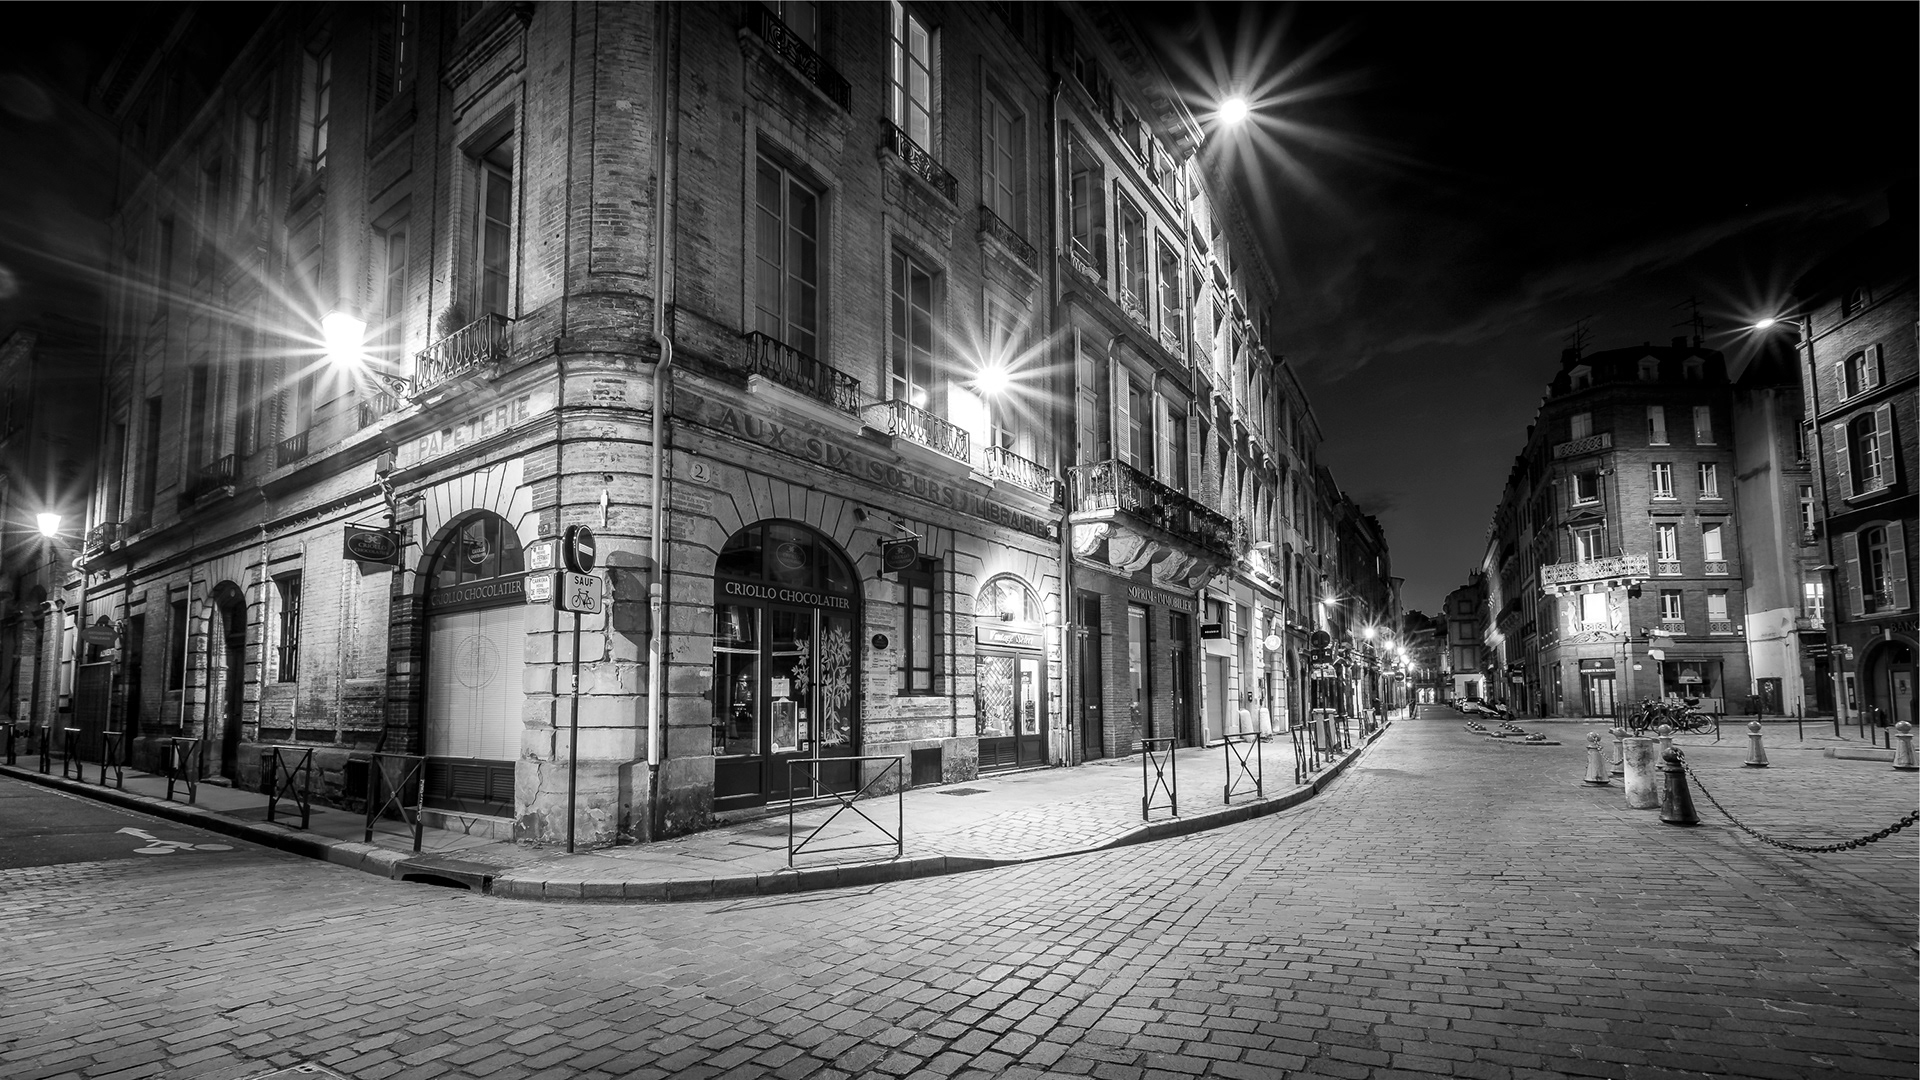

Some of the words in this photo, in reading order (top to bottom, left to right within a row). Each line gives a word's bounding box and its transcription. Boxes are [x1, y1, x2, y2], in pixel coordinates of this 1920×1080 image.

[418, 394, 531, 459] PAPETERIE
[719, 407, 787, 449] AUX
[806, 438, 851, 469] SIX
[975, 497, 1045, 537] LIBRAIRIE
[431, 590, 463, 606] CRIOLLO
[464, 580, 523, 601] CHOCOLATIER
[574, 575, 594, 587] SAUF
[725, 582, 777, 599] CRIOLLO
[780, 589, 850, 609] CHOCOLATIER
